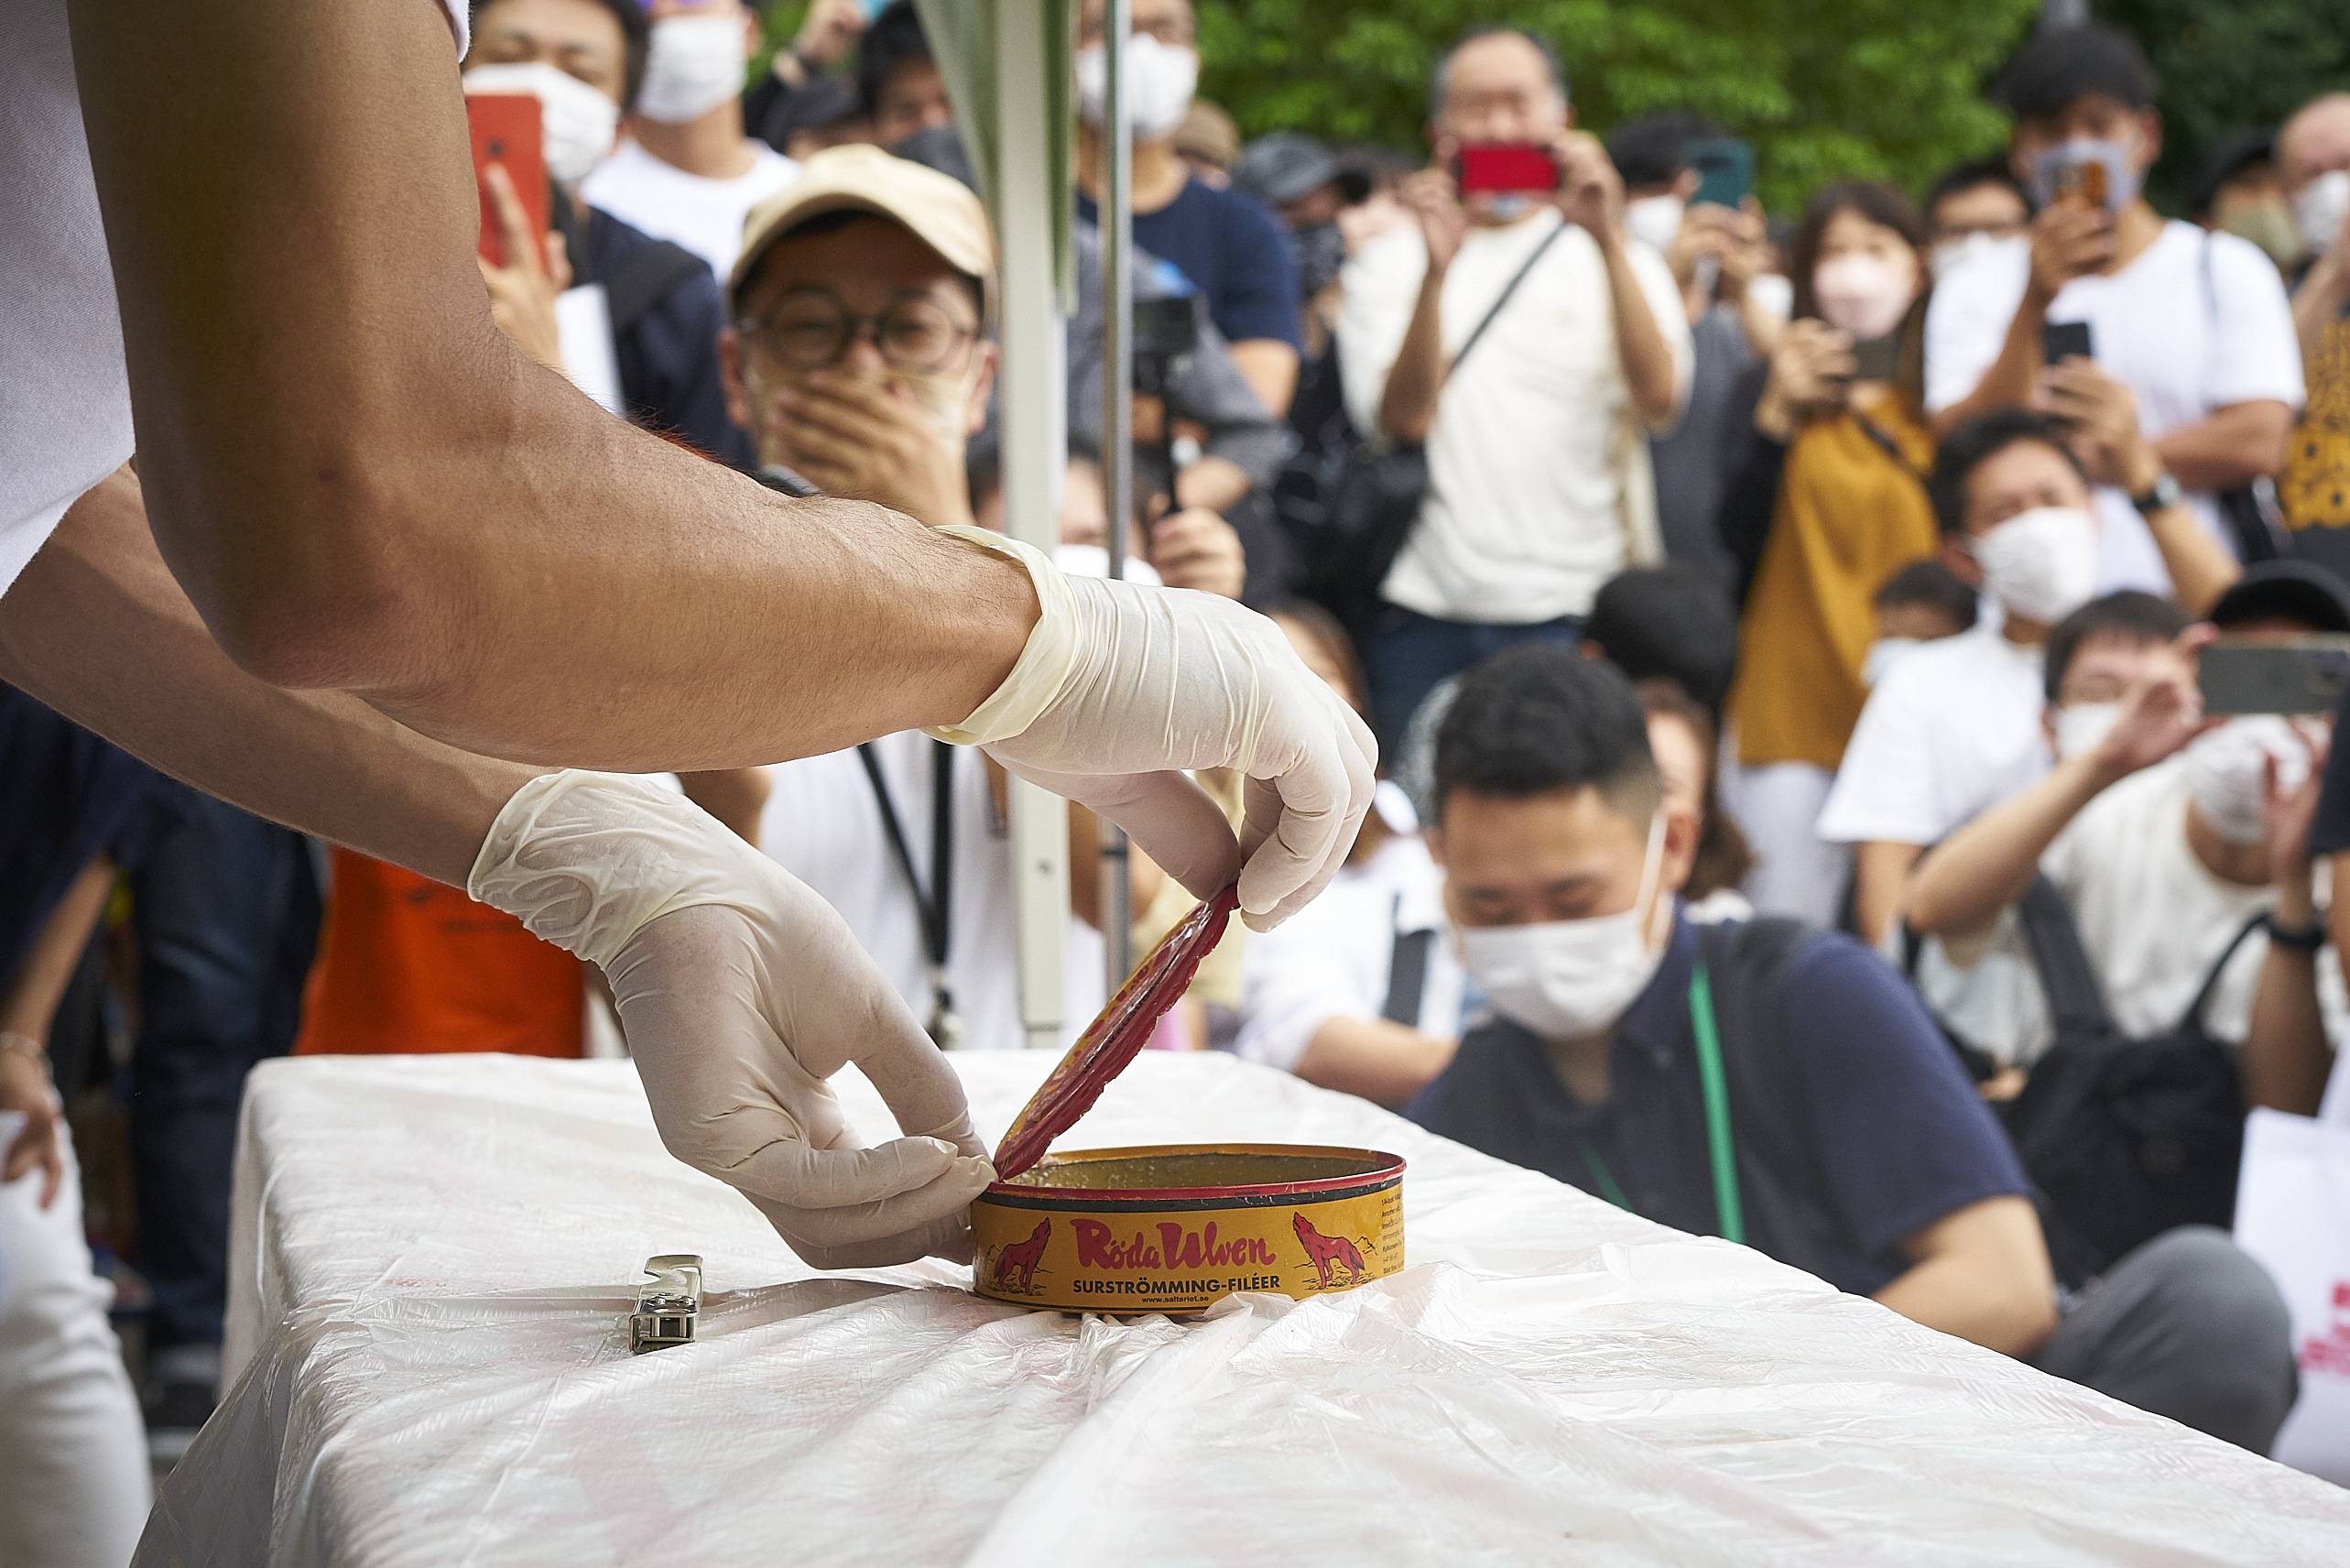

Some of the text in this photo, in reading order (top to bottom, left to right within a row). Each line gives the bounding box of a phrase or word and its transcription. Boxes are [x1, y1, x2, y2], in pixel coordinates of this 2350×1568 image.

[1070, 1218, 1277, 1270] Röda Ulven
[1073, 1273, 1280, 1294] SURSTRÖMMING-FILÉER
